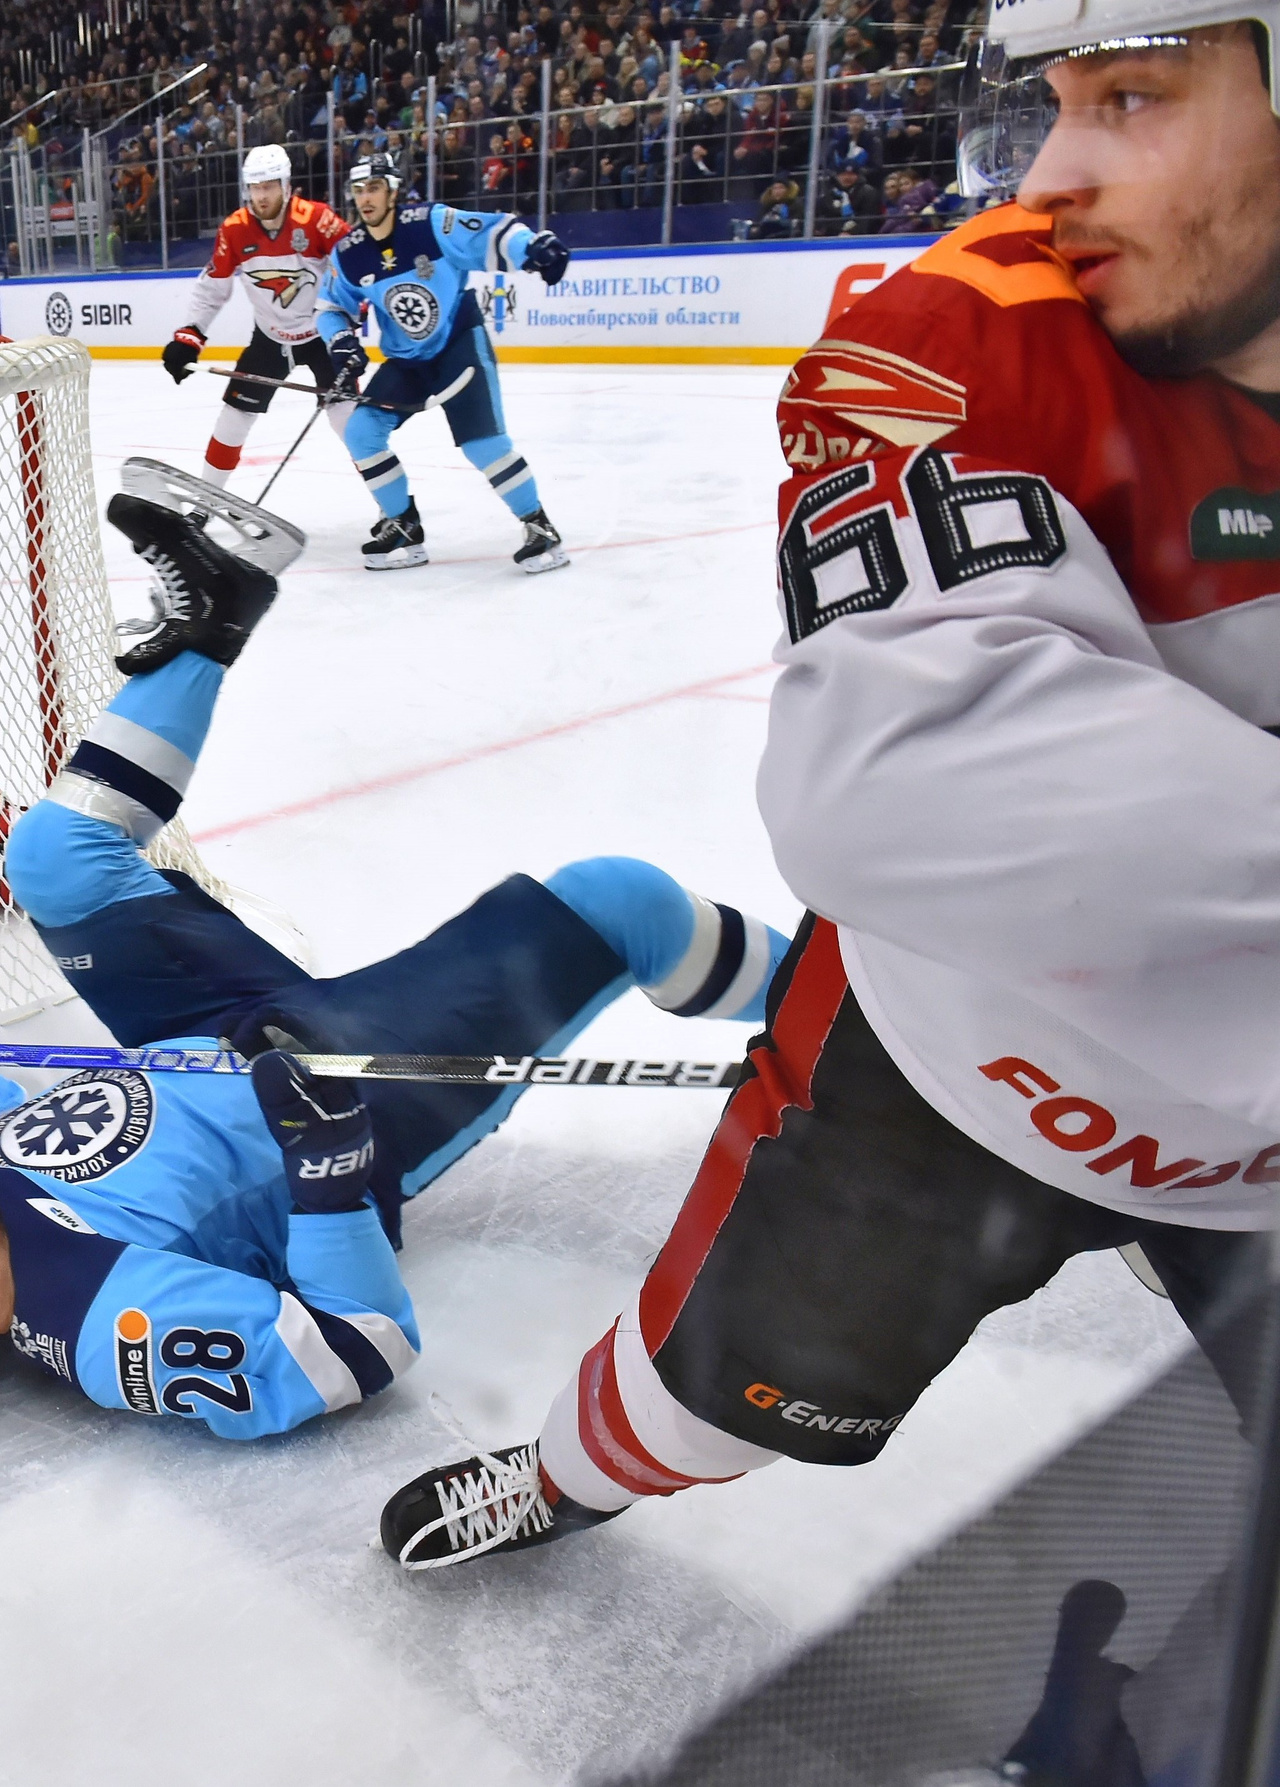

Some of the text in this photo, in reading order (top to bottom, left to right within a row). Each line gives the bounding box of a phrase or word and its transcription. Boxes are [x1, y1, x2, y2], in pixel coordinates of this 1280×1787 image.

[545, 275, 721, 298] ПРАВИТЕЛЬСТВО
[81, 303, 132, 326] SIBIR
[526, 307, 741, 330] Новосибирской области
[777, 445, 1068, 645] 66
[484, 1055, 728, 1087] BAUER
[298, 1137, 375, 1179] UER
[50, 1206, 79, 1228] МИР
[35, 1332, 59, 1370] СИБ
[126, 1348, 153, 1412] winline
[159, 1325, 254, 1415] 28
